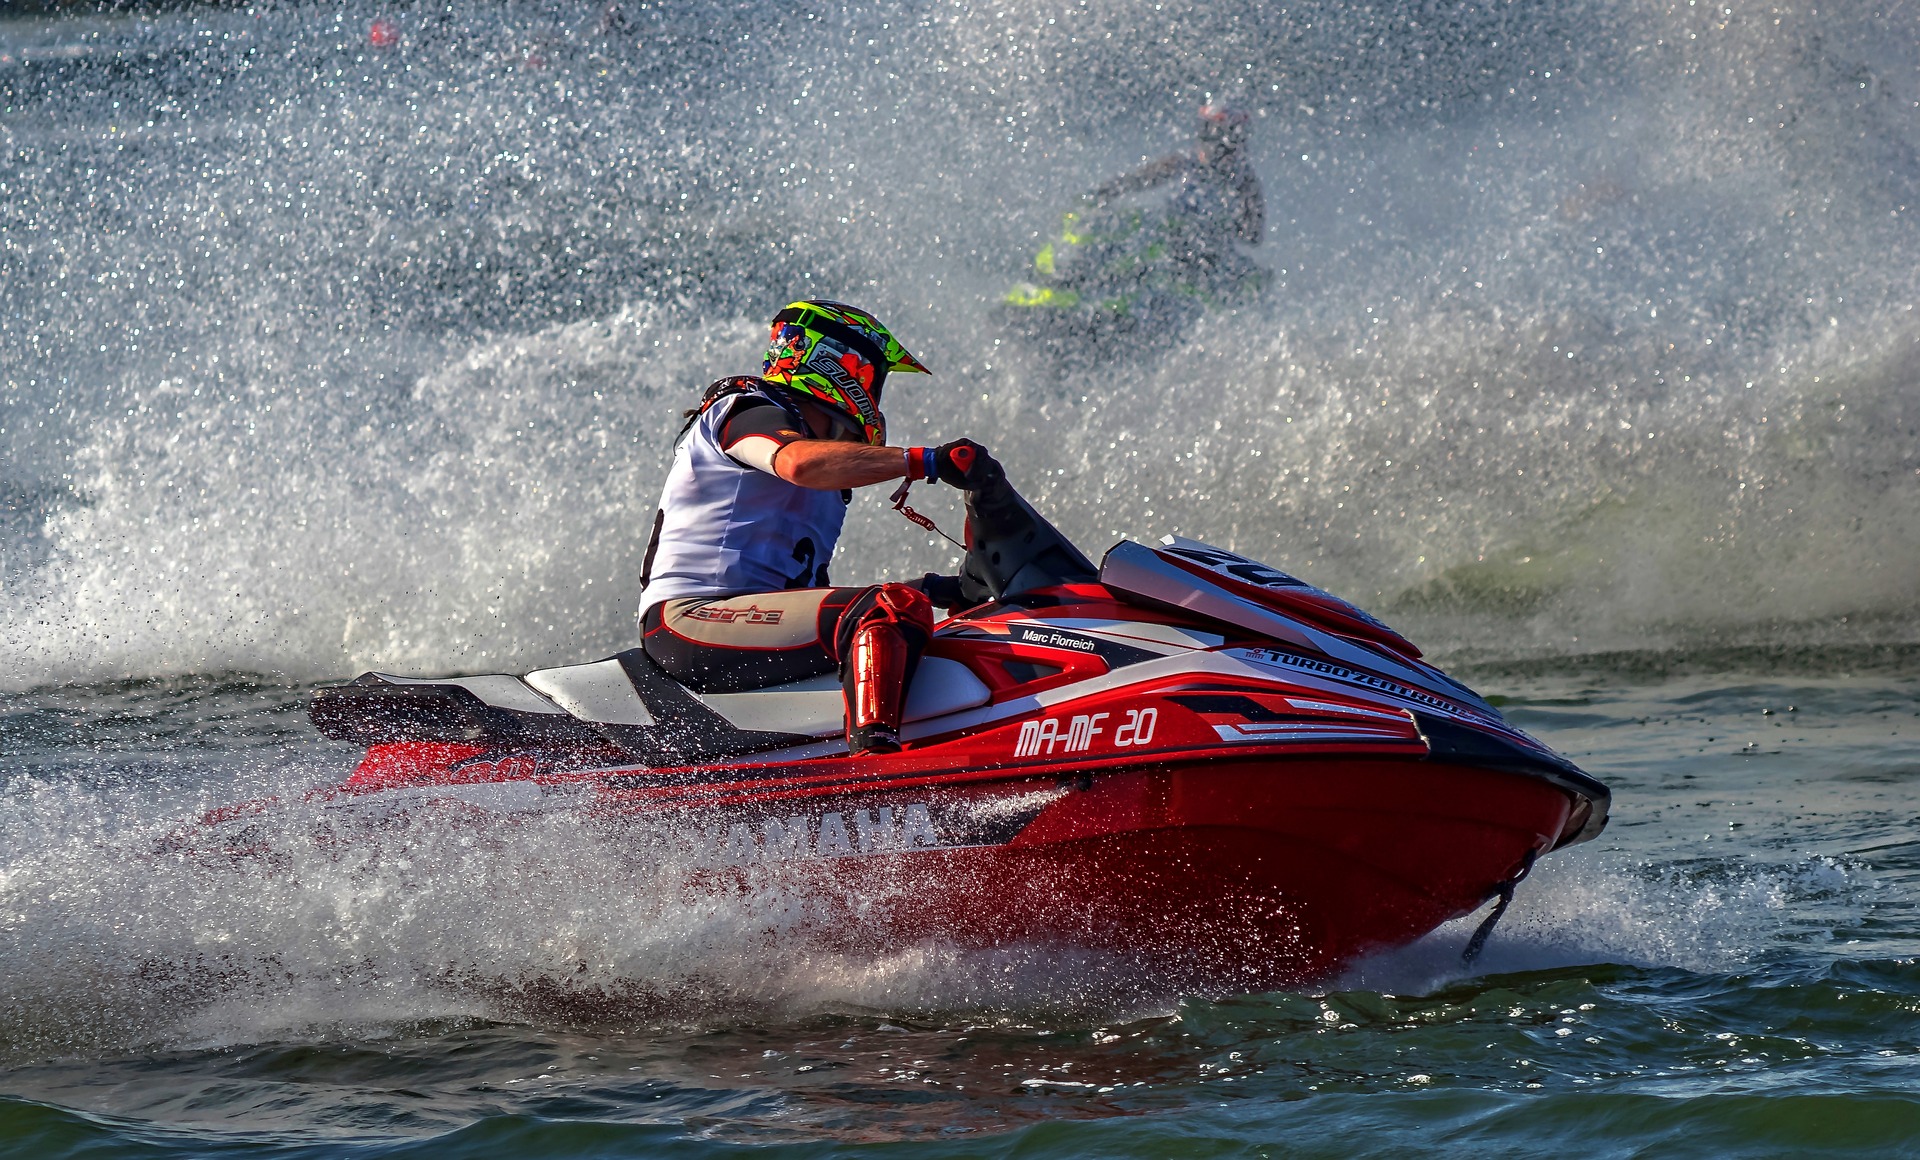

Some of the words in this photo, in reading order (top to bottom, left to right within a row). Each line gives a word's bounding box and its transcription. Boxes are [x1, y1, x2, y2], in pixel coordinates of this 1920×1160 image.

[809, 357, 879, 425] SUOMY
[1021, 629, 1049, 643] Marc
[1050, 633, 1095, 651] Florreich
[1013, 712, 1110, 758] MA-MF
[1114, 707, 1159, 747] 20
